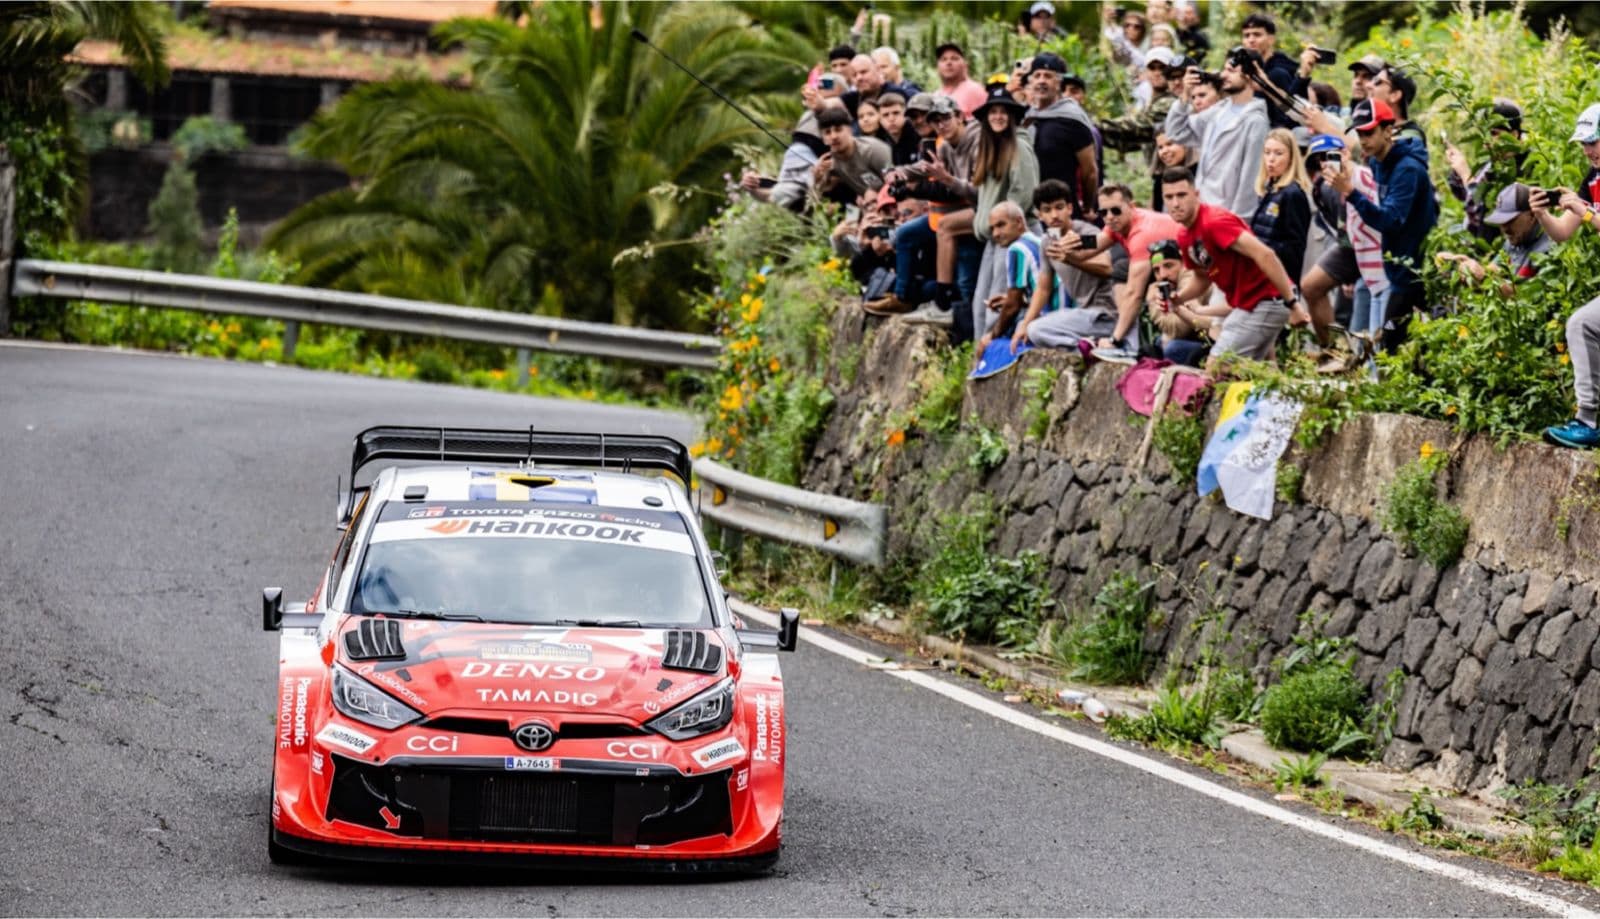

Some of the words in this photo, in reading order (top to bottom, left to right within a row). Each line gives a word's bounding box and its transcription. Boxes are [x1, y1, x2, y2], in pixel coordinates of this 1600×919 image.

[528, 508, 596, 519] GAZOO
[599, 513, 662, 529] Racing
[461, 662, 605, 681] DENSO
[476, 689, 598, 706] TAMADIC
[280, 677, 293, 749] AUTOMOTIVE
[294, 677, 311, 746] Panasonic
[516, 761, 550, 769] A-7645
